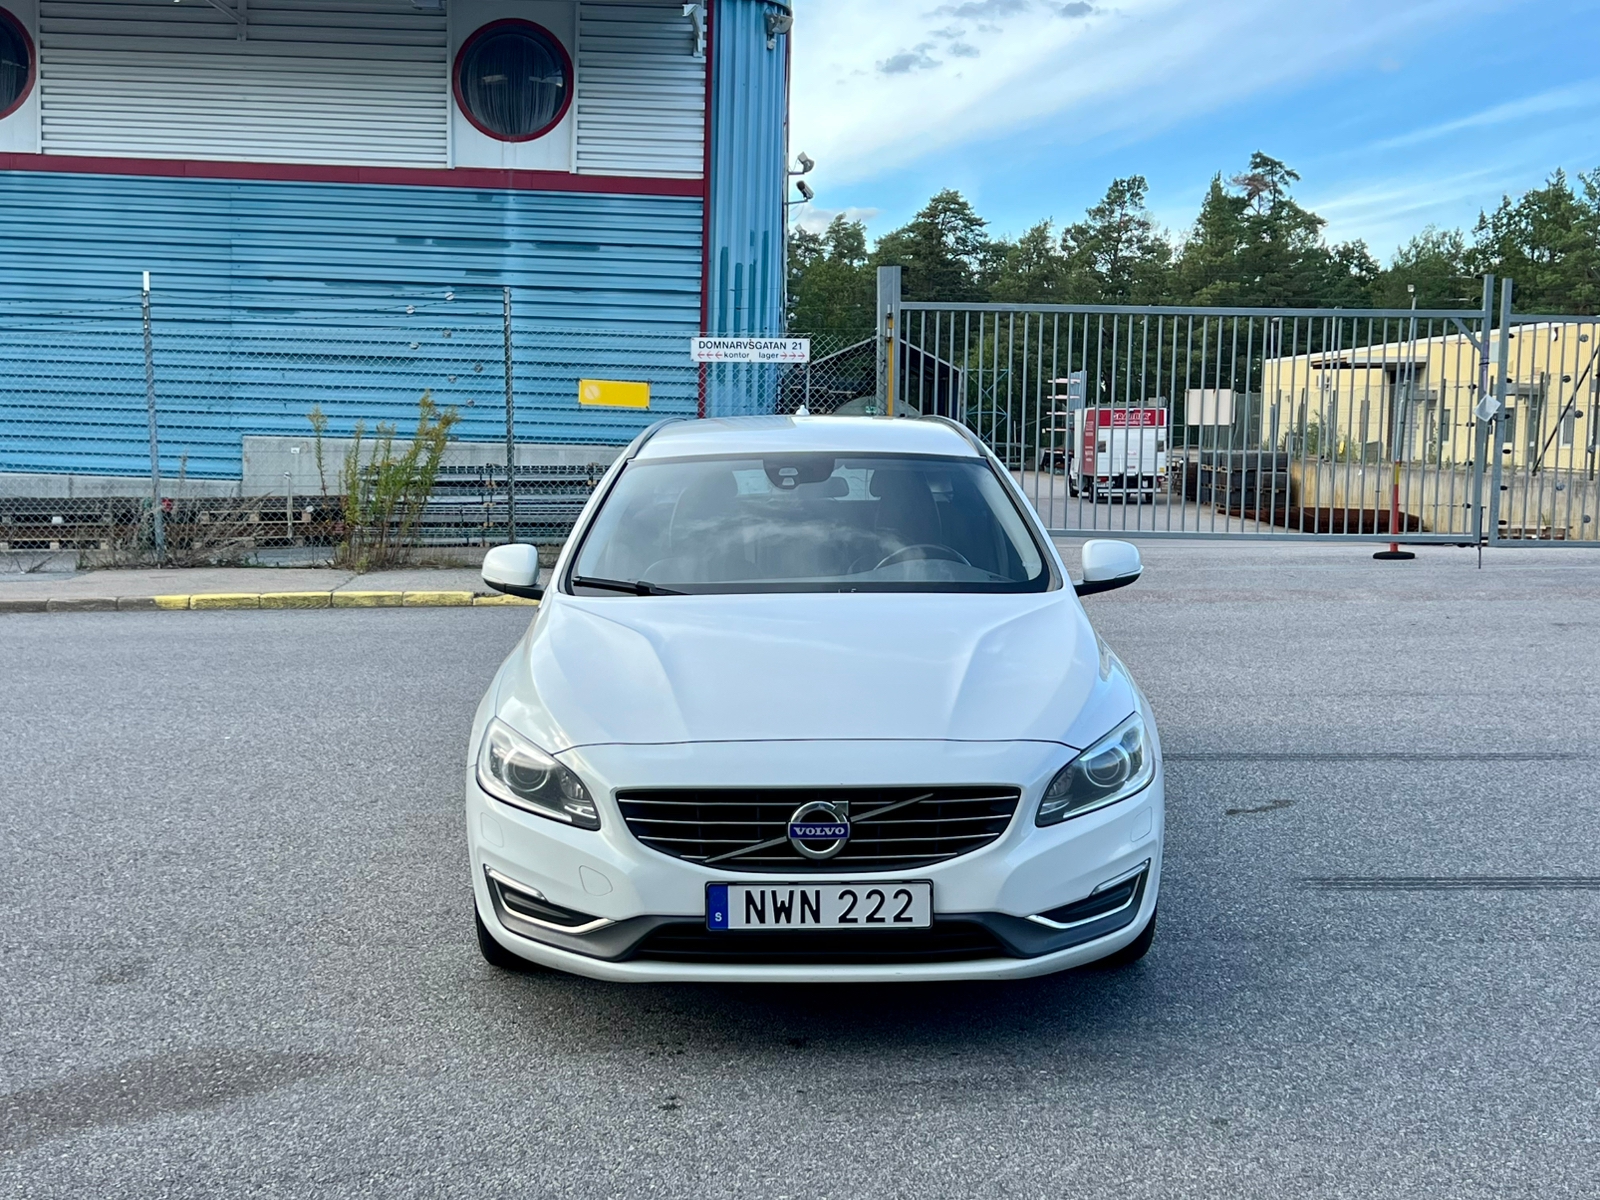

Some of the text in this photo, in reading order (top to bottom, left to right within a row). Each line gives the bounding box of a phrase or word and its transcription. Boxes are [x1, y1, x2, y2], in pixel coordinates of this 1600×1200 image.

[698, 341, 802, 350] DOMNARVSGATAN 21
[723, 351, 779, 360] kontor lager
[793, 826, 845, 836] VOLVO
[715, 888, 914, 924] S NWN 222
